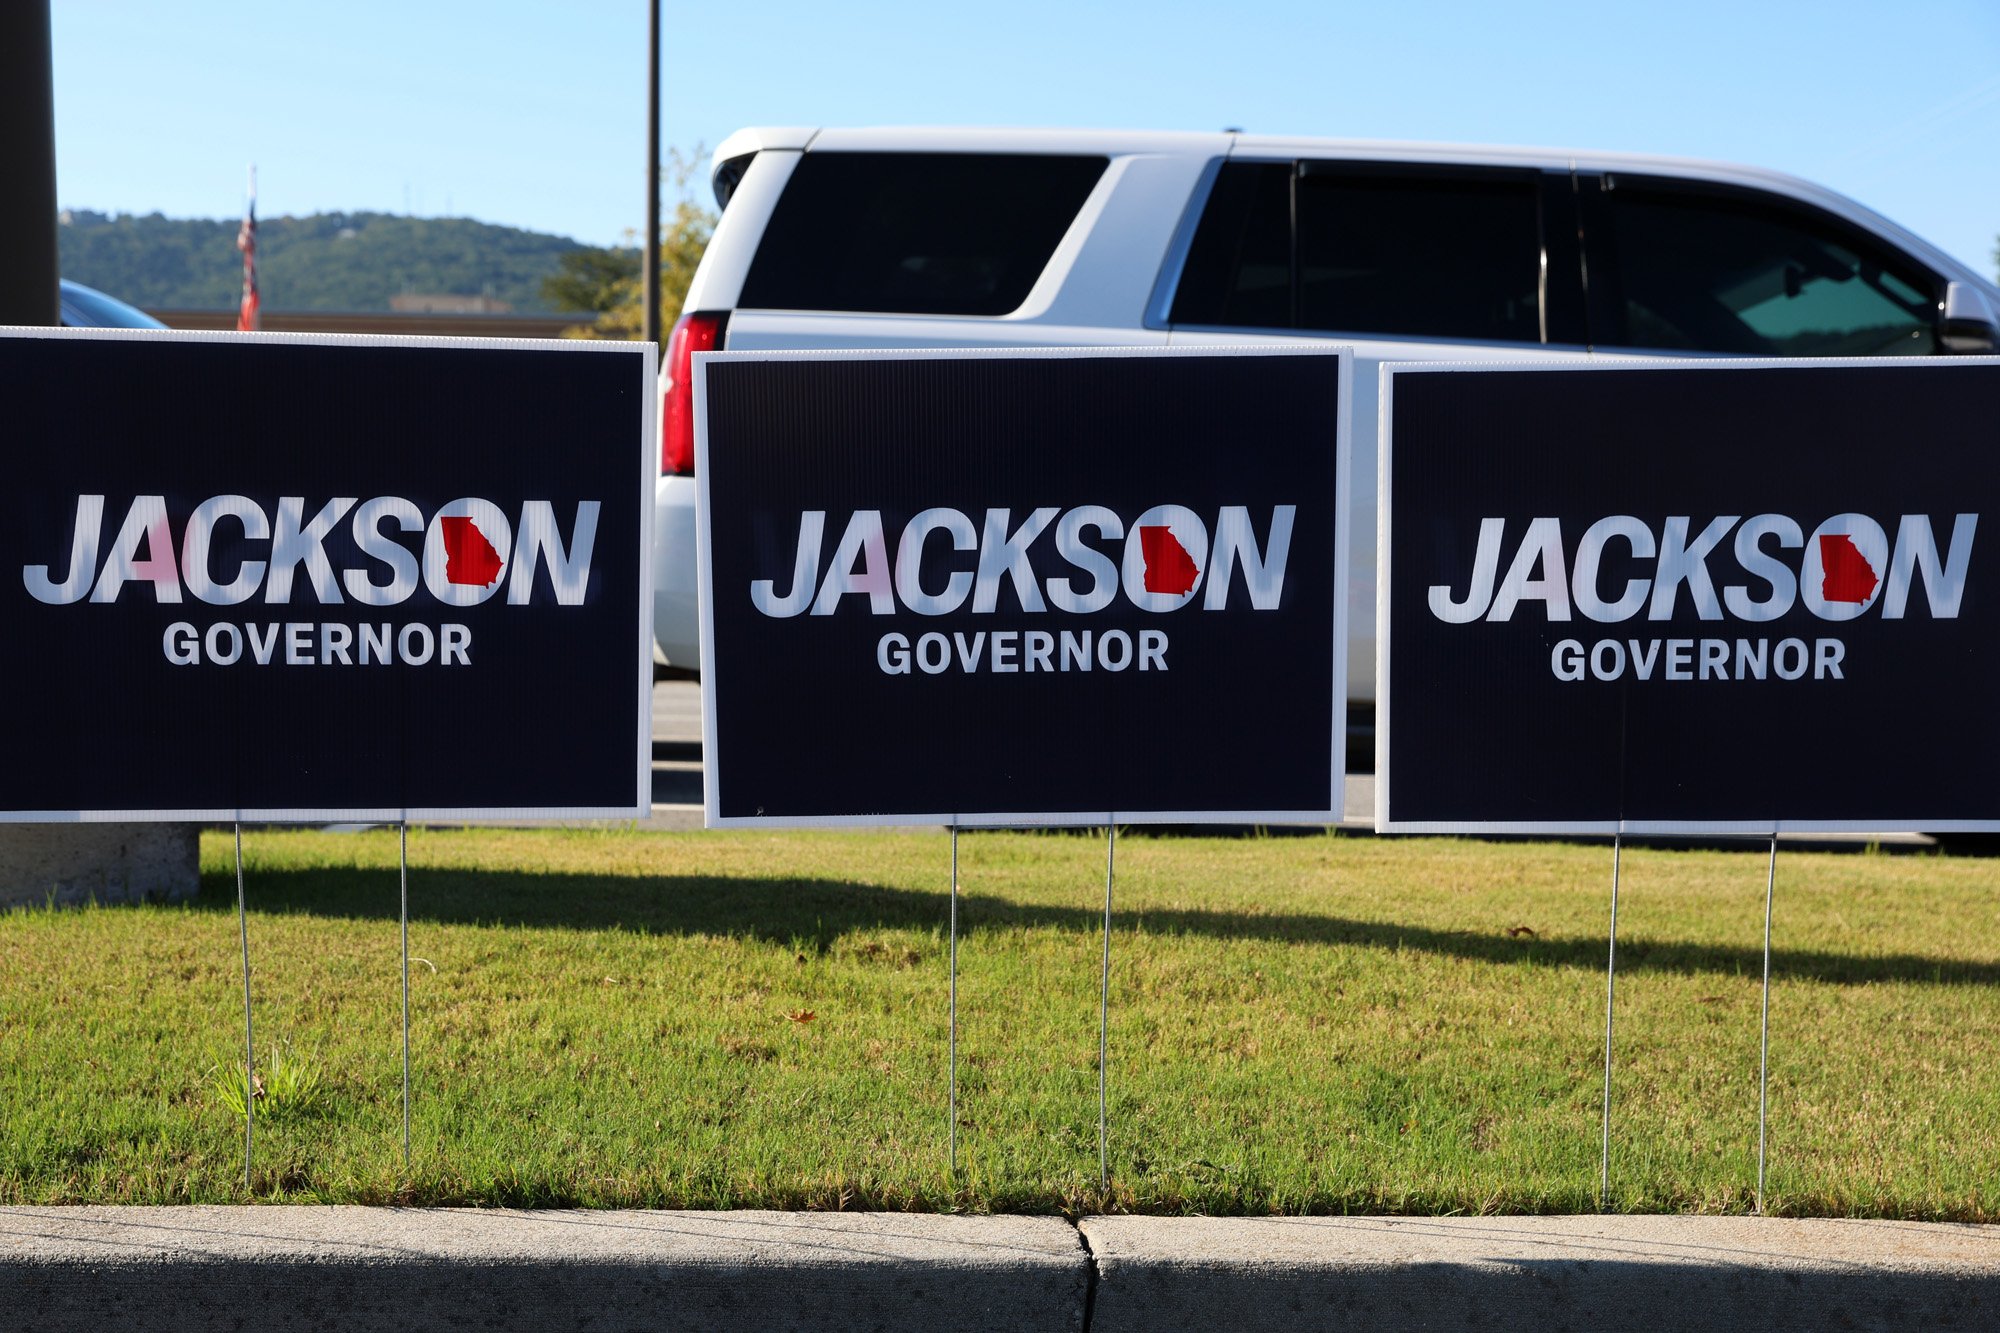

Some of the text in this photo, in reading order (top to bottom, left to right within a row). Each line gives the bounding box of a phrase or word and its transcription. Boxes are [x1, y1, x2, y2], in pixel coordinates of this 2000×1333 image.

[23, 495, 602, 607] JACKSON
[751, 504, 1296, 618] JACKSON
[1428, 512, 1978, 623] JACKSON
[163, 621, 472, 666] GOVERNOR
[877, 629, 1168, 675] GOVERNOR
[1552, 637, 1845, 682] GOVERNOR
